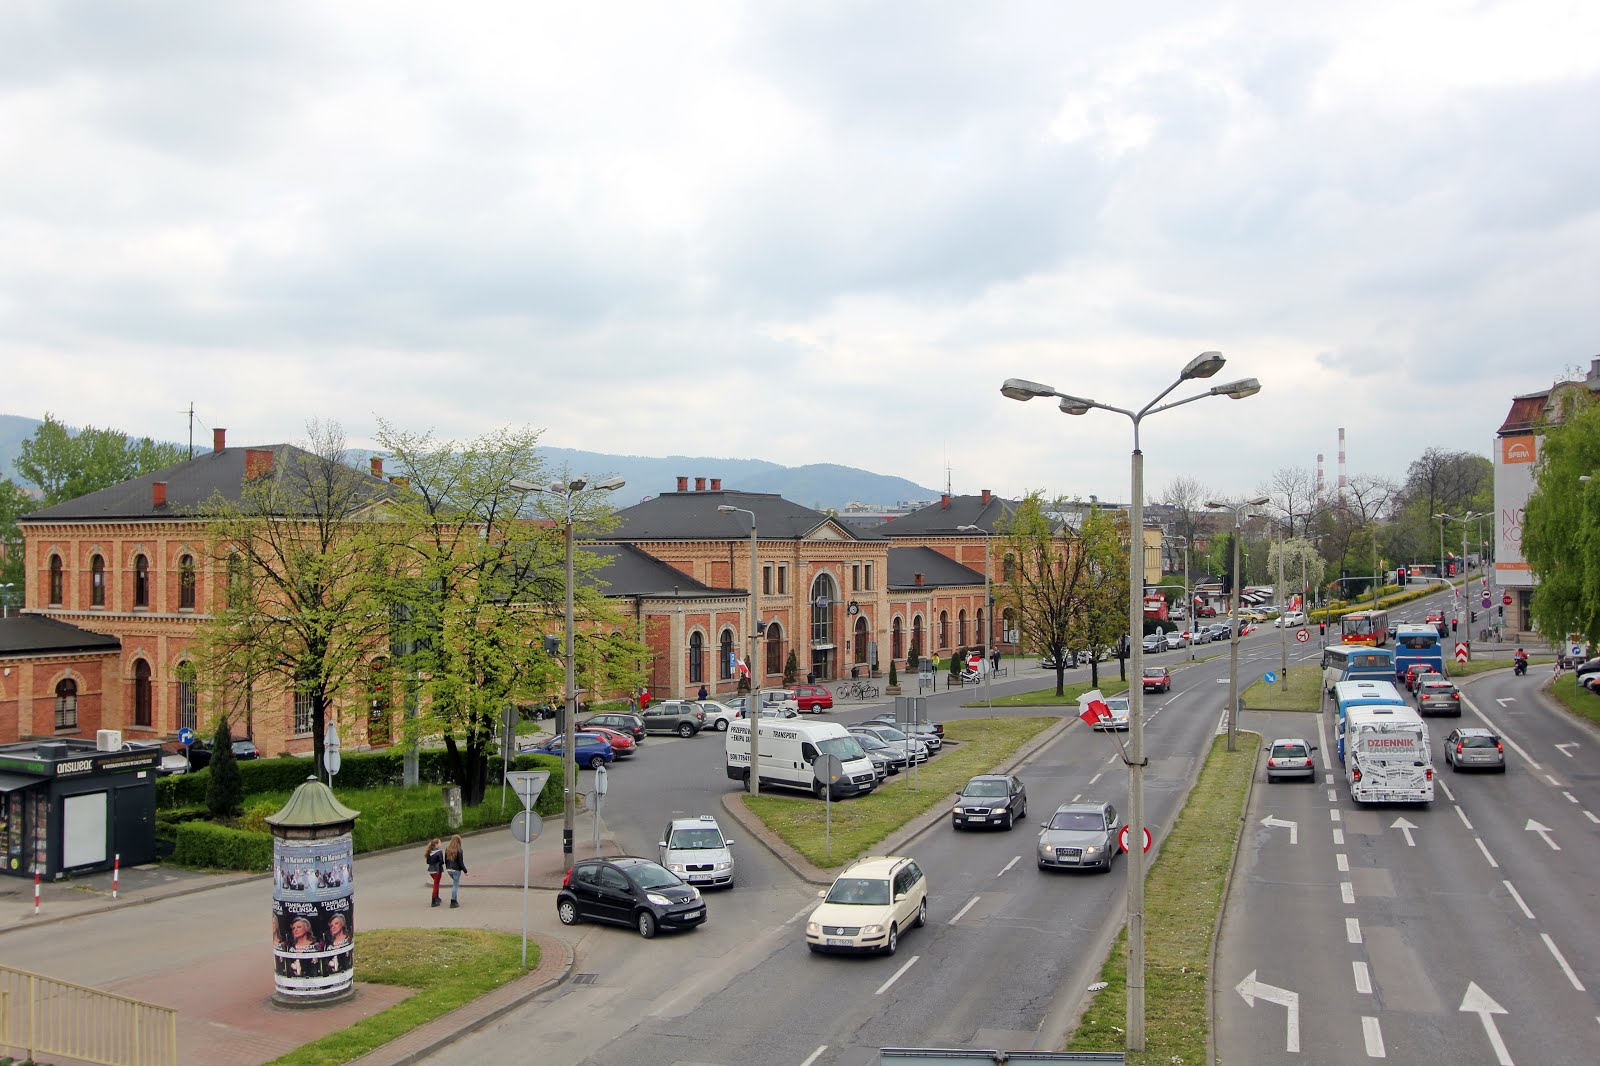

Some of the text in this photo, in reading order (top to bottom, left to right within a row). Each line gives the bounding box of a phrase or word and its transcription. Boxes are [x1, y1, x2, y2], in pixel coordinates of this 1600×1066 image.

[1508, 450, 1530, 459] SFERA
[773, 730, 797, 739] TRANSPORT
[1367, 739, 1414, 747] DZIENNIK
[57, 760, 93, 774] answear
